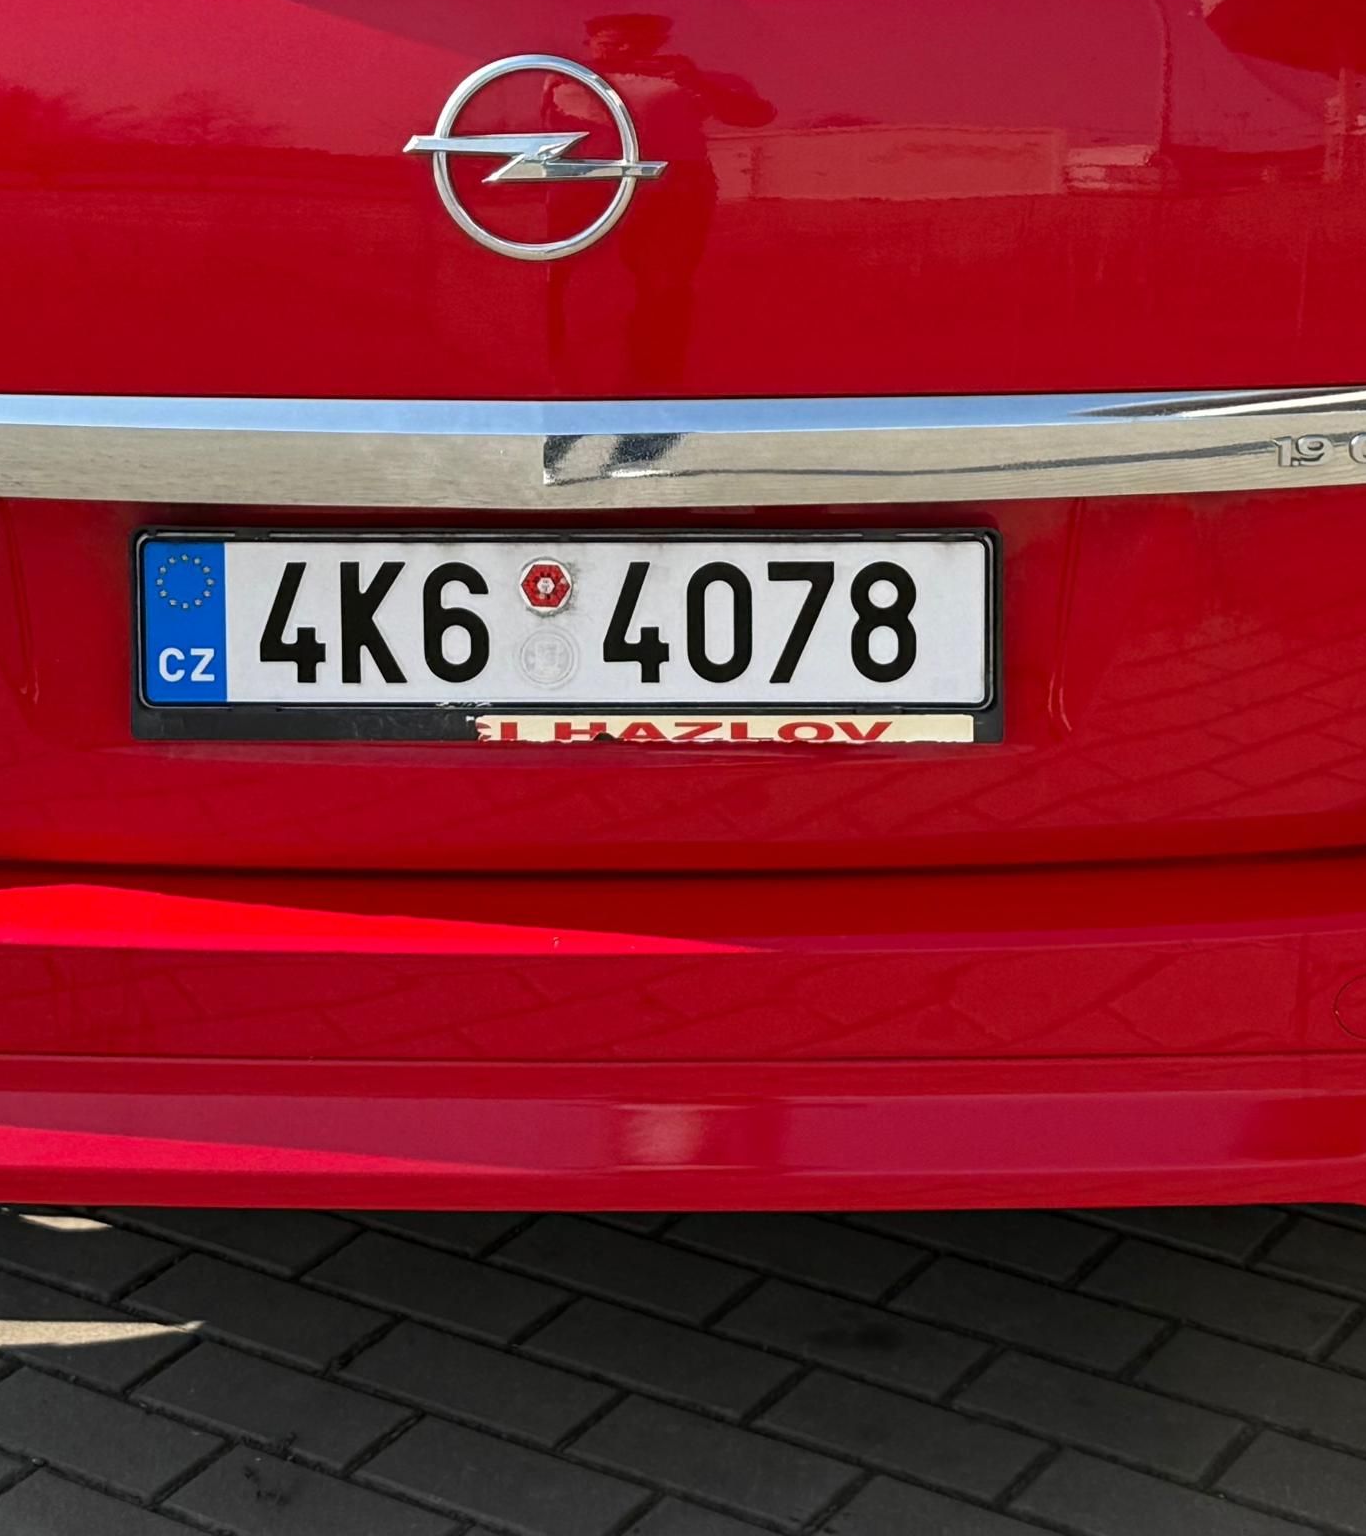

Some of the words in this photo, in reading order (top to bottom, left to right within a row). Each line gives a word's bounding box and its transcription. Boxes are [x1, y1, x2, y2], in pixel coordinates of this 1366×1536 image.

[1273, 433, 1333, 467] 1.9
[260, 561, 490, 684] 4K6
[603, 560, 917, 684] 4078
[158, 647, 216, 683] CZ
[554, 720, 894, 742] HAZLOV
